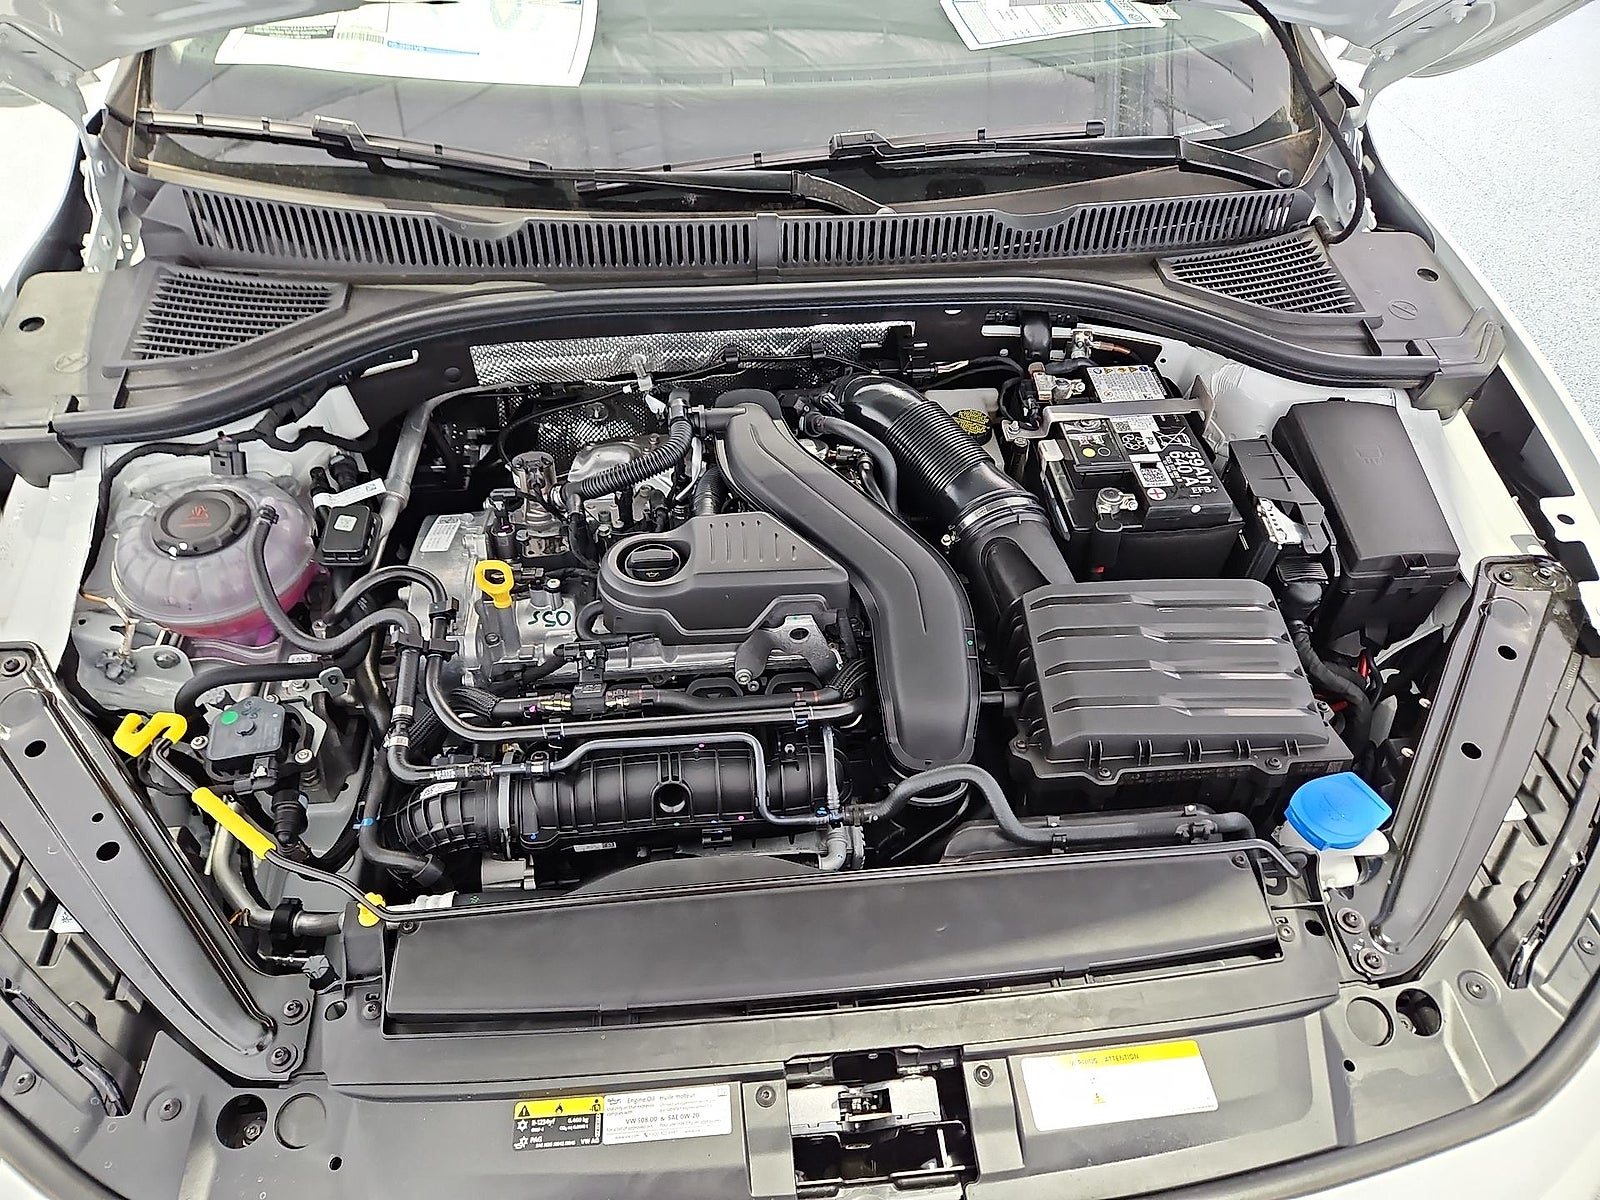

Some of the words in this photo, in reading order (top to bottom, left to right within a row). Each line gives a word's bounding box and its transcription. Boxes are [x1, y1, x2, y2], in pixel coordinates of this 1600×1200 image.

[1145, 436, 1154, 445] Pb
[1169, 450, 1193, 474] 640
[1181, 476, 1200, 487] A
[1184, 451, 1214, 484] 59Ah
[1191, 486, 1219, 494] EFB+
[627, 1096, 646, 1105] Engine
[580, 1137, 591, 1145] VW
